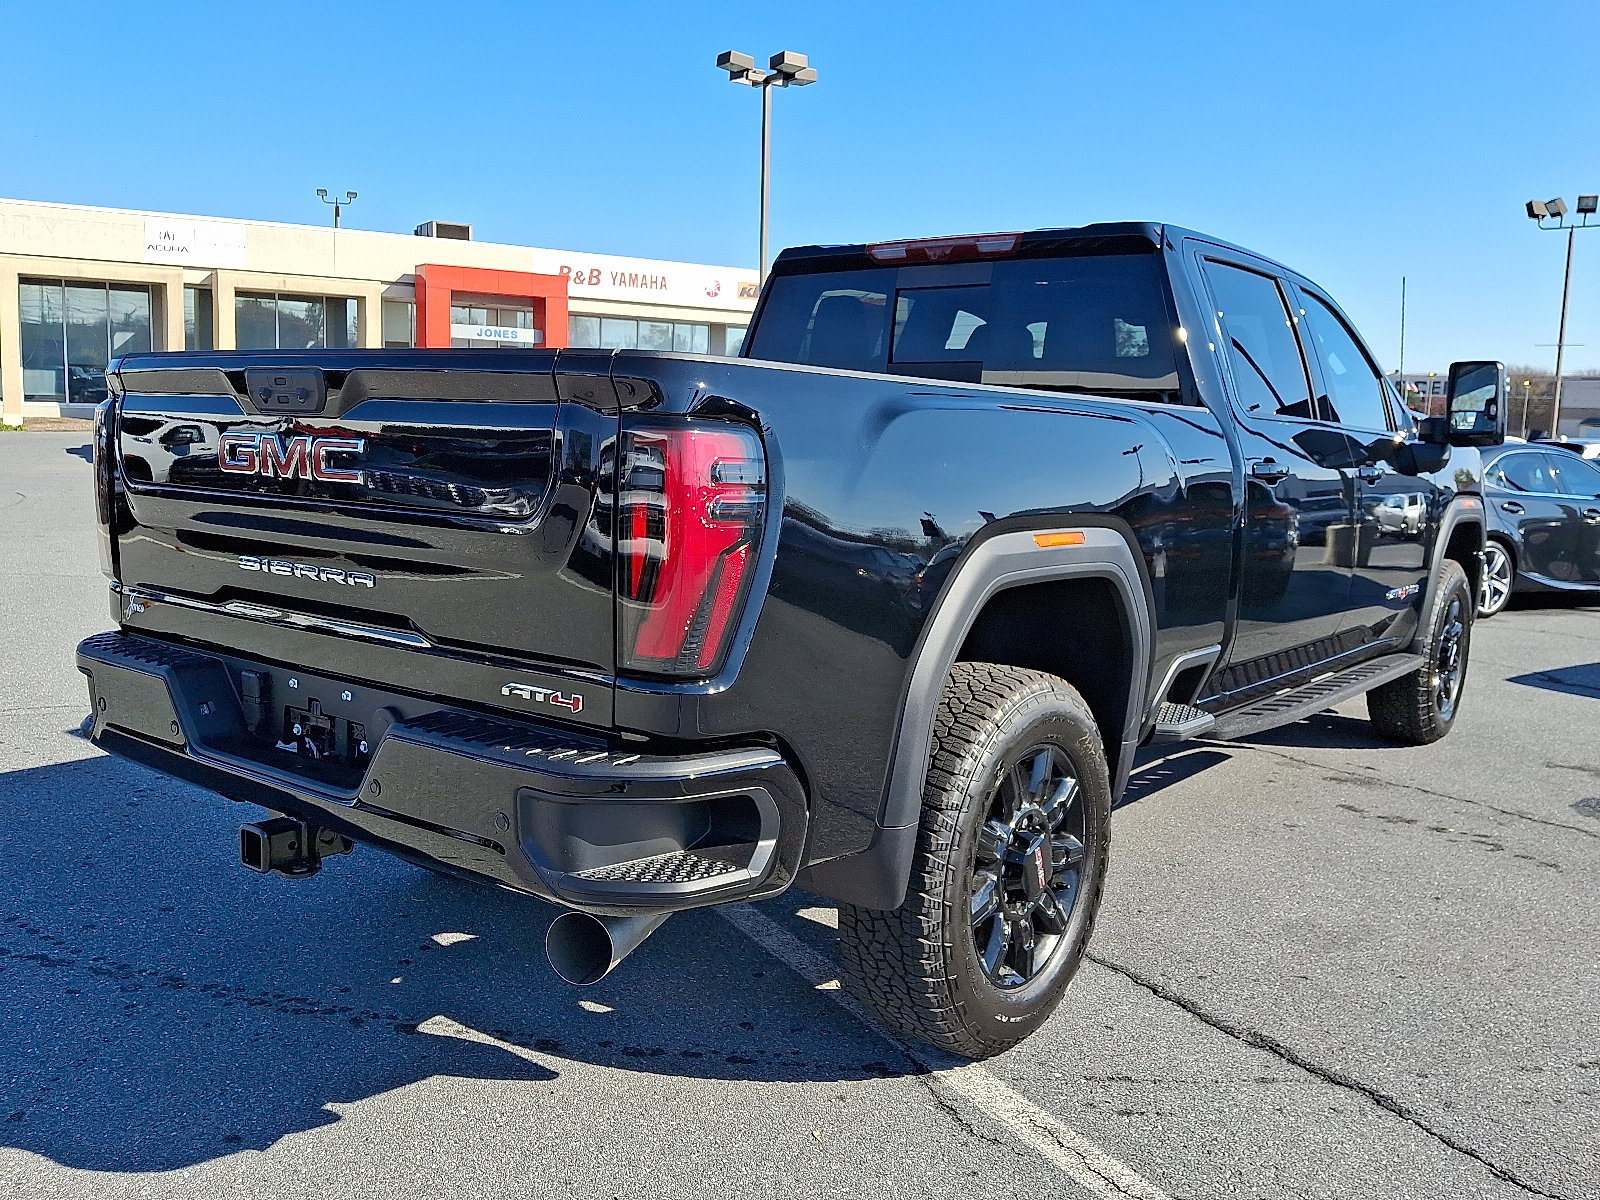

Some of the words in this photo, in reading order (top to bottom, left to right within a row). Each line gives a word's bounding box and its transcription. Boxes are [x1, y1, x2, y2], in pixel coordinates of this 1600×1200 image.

[559, 265, 602, 286] B&B
[610, 271, 667, 290] YAMAHA
[477, 328, 518, 339] JONES
[218, 431, 365, 485] GMC
[237, 554, 376, 588] SIERRA
[501, 682, 584, 713] AT4
